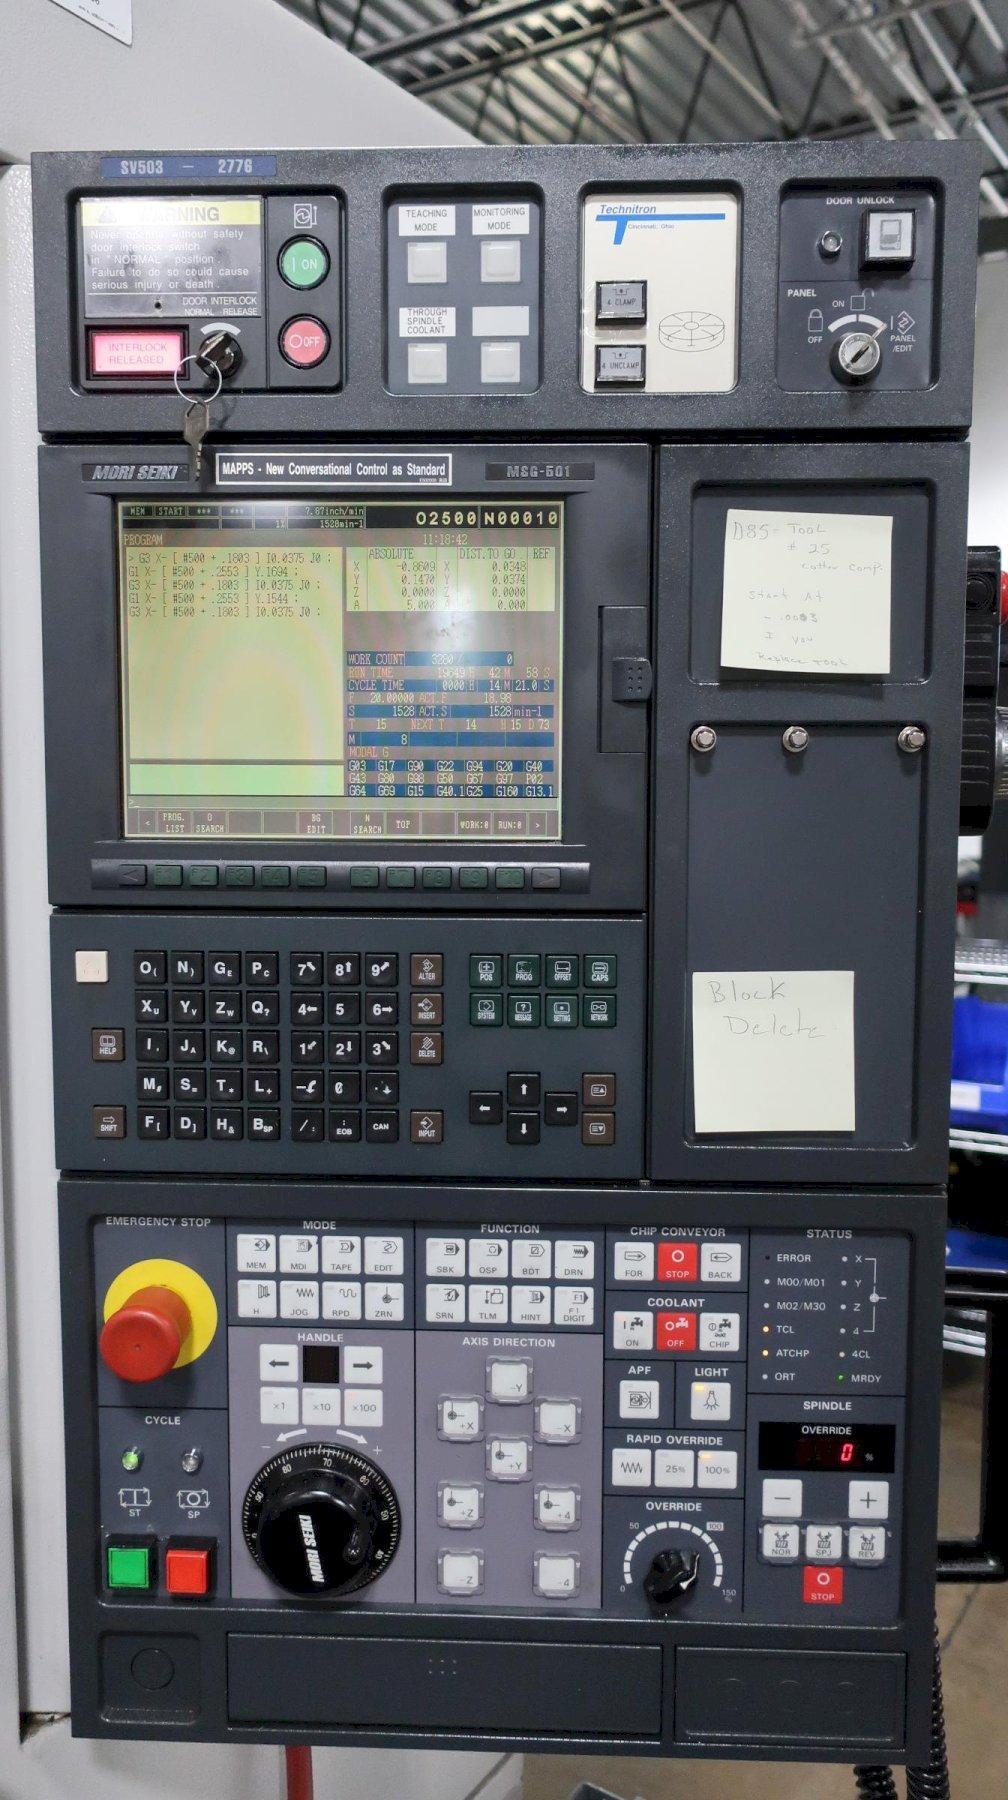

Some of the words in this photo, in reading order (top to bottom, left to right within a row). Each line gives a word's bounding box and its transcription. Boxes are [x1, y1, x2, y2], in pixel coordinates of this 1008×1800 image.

[120, 161, 163, 174] SV503
[218, 160, 252, 173] 2776
[826, 197, 852, 205] DOOR
[857, 196, 894, 204] UNLOCK
[406, 209, 447, 218] TEACHING
[473, 208, 525, 217] MONITORING
[600, 204, 656, 214] Technitron
[141, 207, 219, 221] ARNING
[414, 223, 437, 232] MODE
[488, 222, 511, 230] MODE
[214, 231, 243, 240] safety
[302, 260, 317, 269] ON
[186, 268, 212, 276] could
[135, 282, 162, 290] injury
[788, 289, 817, 297] PANEL
[615, 298, 636, 306] CLAMP
[408, 309, 447, 317] THROUGH
[408, 317, 442, 325] SPINDLE
[408, 326, 445, 334] COOLANT
[109, 343, 168, 352] INTERLOCK
[109, 356, 164, 364] RELEASED
[610, 361, 639, 369] UNCLAMP
[92, 466, 134, 479] MORI
[137, 466, 179, 479] SEIKI
[222, 462, 254, 475] MAPPS
[266, 462, 284, 475] New
[289, 462, 351, 475] Conversational
[356, 462, 388, 475] Control
[392, 466, 402, 475] as
[406, 462, 446, 476] Standard
[158, 507, 183, 515] START
[484, 511, 558, 525] N00010
[124, 535, 162, 545] PROGRAM
[423, 535, 468, 545] 11:18:42
[368, 549, 413, 558] ABSOLUTE
[809, 544, 830, 554] 25
[349, 655, 370, 664] WORK
[376, 655, 404, 664] COUNT
[371, 668, 393, 677] TIME
[349, 681, 376, 690] CYCLE
[381, 681, 404, 690] TIME
[393, 706, 415, 716] 1528
[496, 762, 513, 771] G20
[526, 762, 542, 771] G40
[163, 813, 185, 821] PROG.
[353, 826, 381, 834] SEARCH
[709, 977, 785, 1002] Block
[336, 1004, 344, 1015] 5
[106, 1217, 176, 1226] EMERGENCY
[181, 1218, 211, 1226] STOP
[303, 1221, 336, 1230] MODE
[481, 1224, 539, 1233] FUNCTION
[630, 1227, 657, 1236] CHIP
[662, 1228, 725, 1237] CONVEYOR
[807, 1230, 852, 1238] STATUS
[777, 1254, 811, 1262] ERROR
[777, 1278, 825, 1286] M00/M01
[648, 1298, 705, 1307] COOLANT
[298, 1333, 343, 1342] HANDLE
[462, 1337, 490, 1346] AXIS
[494, 1338, 555, 1347] DIRECTION
[628, 1366, 651, 1374] APF
[694, 1368, 728, 1376] LIGHT
[804, 1402, 852, 1410] SPINDLE
[145, 1416, 180, 1425] CYCLE
[802, 1426, 852, 1434] OVERRIDE
[627, 1435, 661, 1443] RAPID
[667, 1436, 723, 1445] OVERRIDE
[323, 1458, 332, 1467] 70
[646, 1503, 702, 1511] OVERRIDE
